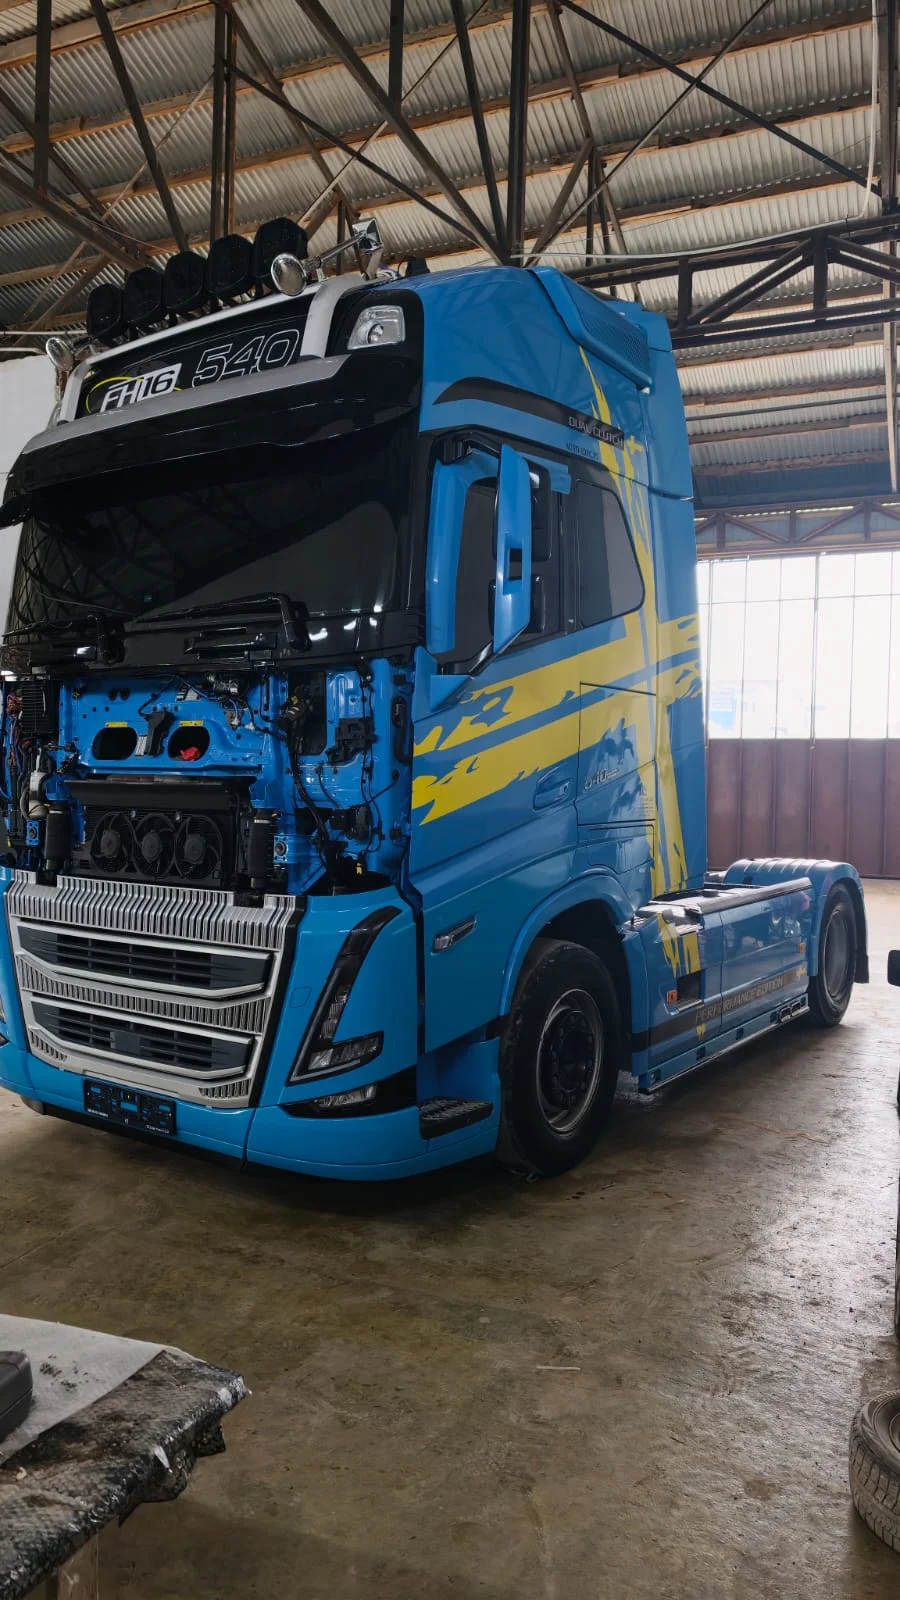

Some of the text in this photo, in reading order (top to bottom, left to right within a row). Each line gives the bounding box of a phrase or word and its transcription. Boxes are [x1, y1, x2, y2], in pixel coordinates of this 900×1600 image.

[101, 329, 299, 413] FH16 540
[695, 986, 757, 1022] PERFORMANCE
